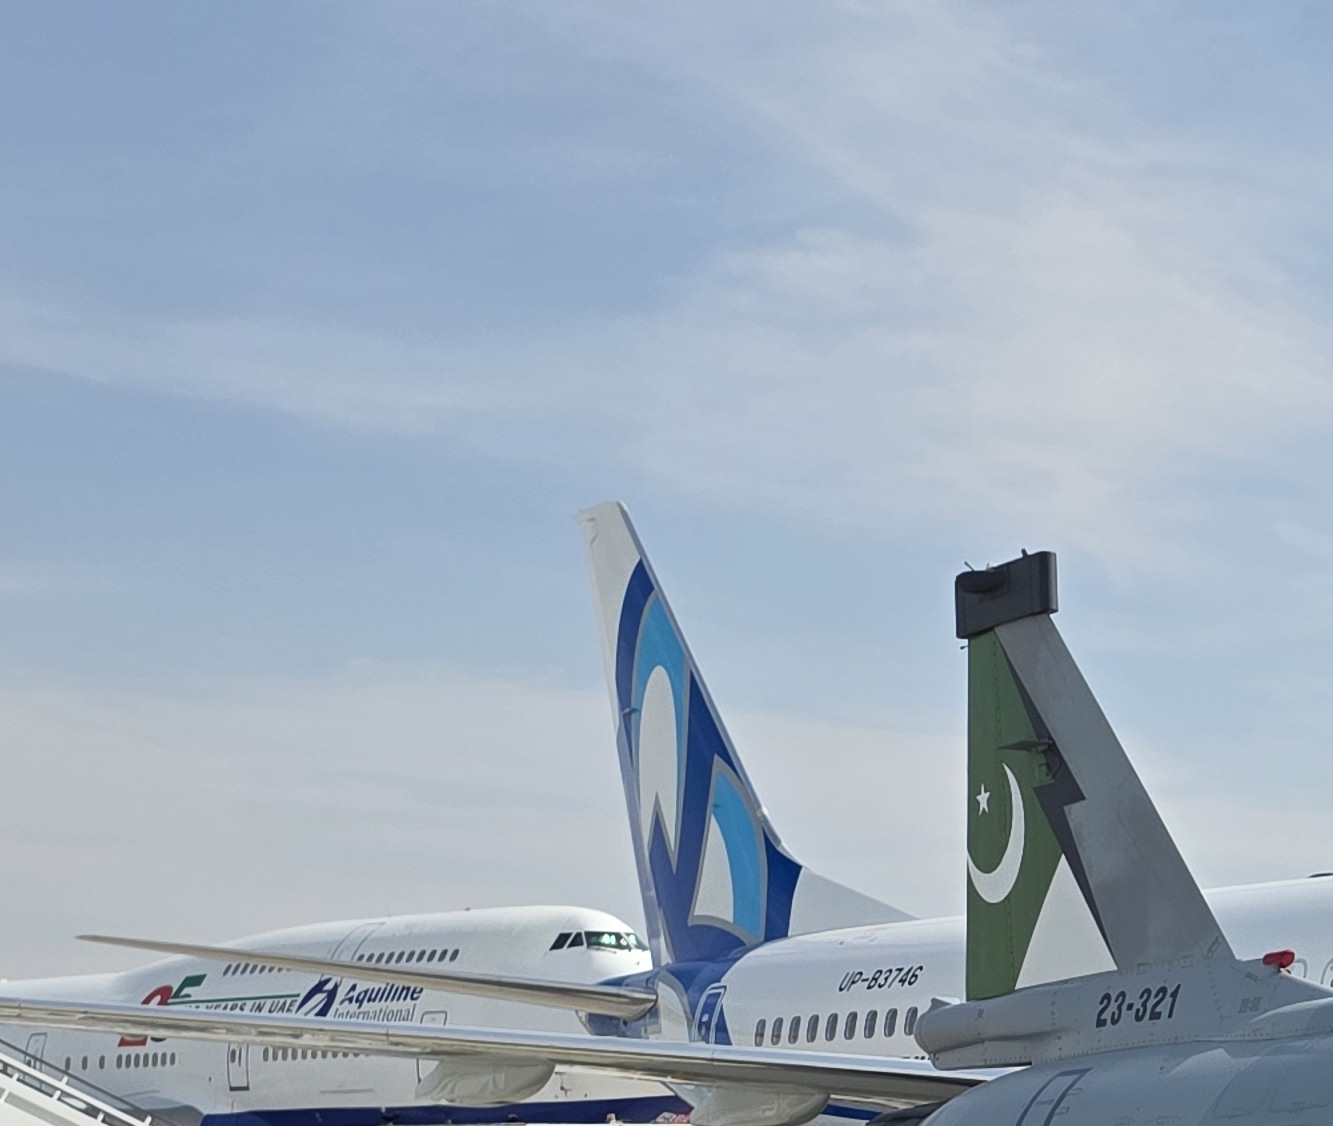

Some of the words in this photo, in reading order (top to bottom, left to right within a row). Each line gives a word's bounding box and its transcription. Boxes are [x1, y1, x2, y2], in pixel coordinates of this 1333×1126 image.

[838, 965, 923, 992] UP-B3746
[268, 999, 298, 1014] UAE
[341, 983, 424, 1009] Aquiline
[1095, 983, 1182, 1028] 23-321
[333, 1003, 417, 1022] International
